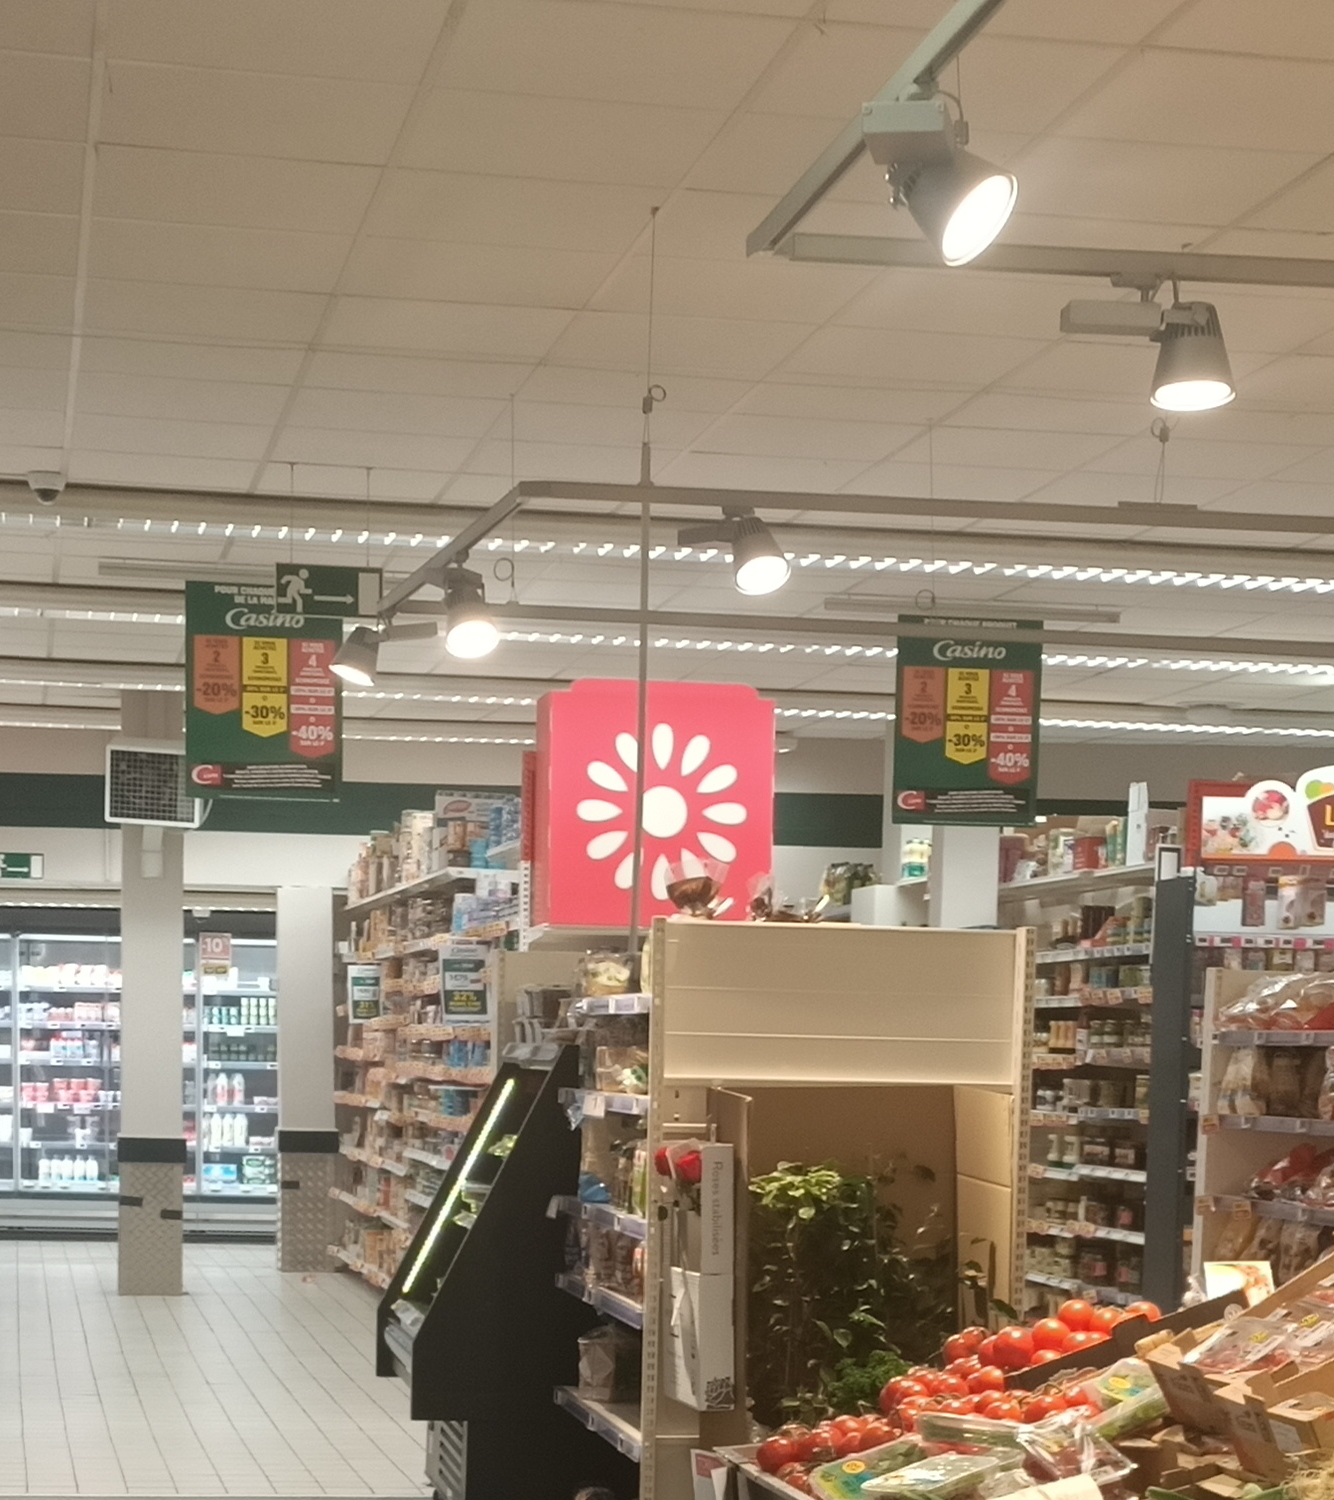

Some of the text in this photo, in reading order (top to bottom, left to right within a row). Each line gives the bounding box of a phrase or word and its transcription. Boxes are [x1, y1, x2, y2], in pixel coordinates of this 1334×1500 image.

[225, 607, 305, 630] Casino
[932, 640, 1007, 661] Casino
[261, 652, 270, 665] 3
[308, 654, 317, 667] 4
[196, 682, 237, 697] -20%
[964, 683, 972, 695] 3
[1007, 684, 1016, 697] 4
[244, 705, 285, 720] -30%
[904, 712, 942, 726] -20%
[291, 725, 334, 741] -40%
[948, 733, 986, 748] -30%
[990, 752, 1030, 767] -40%
[711, 1161, 724, 1195] Roses
